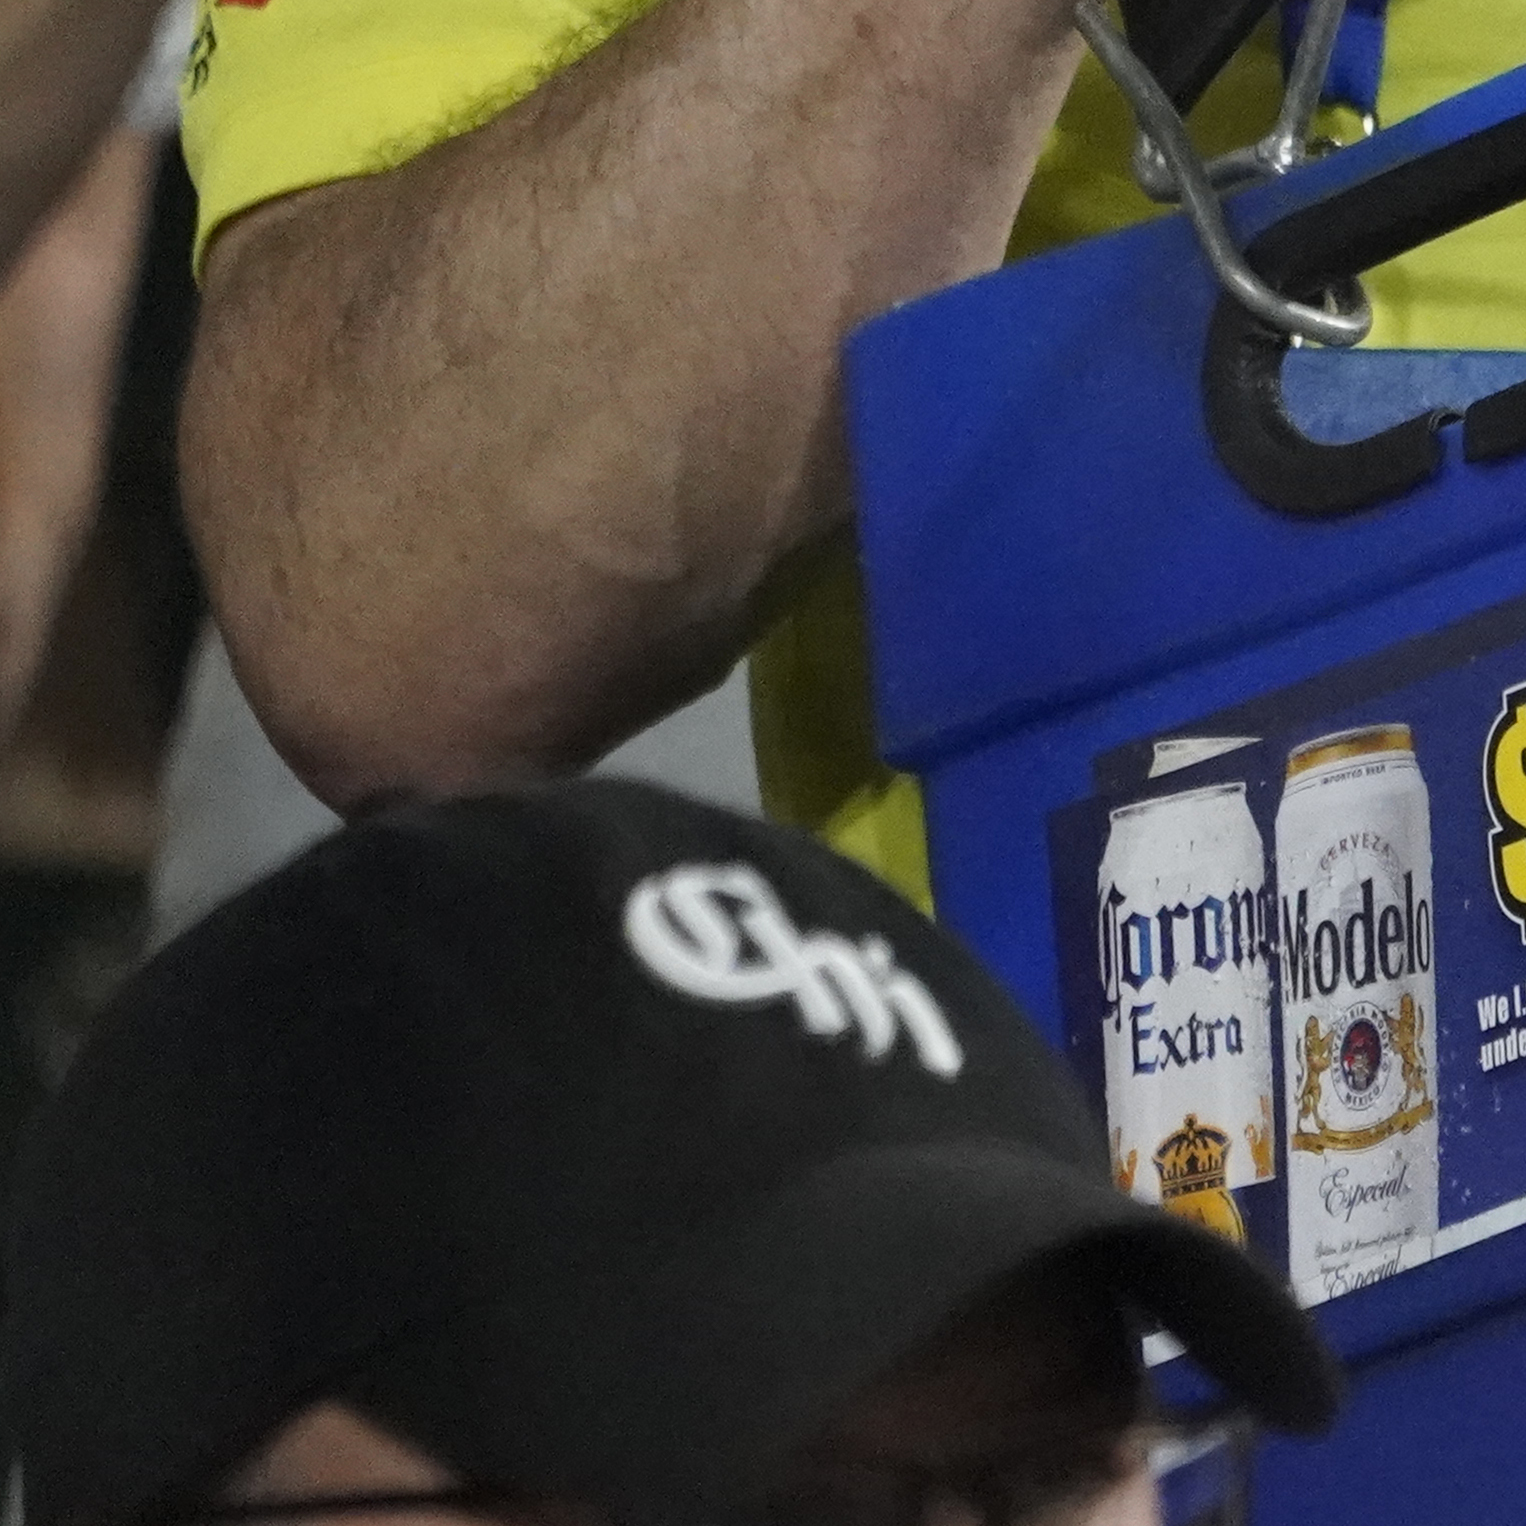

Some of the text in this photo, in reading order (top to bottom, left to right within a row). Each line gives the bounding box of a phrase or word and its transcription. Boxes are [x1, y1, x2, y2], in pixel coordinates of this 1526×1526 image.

[1320, 832, 1391, 871] CERVEZA
[1282, 870, 1431, 1004] Modelo
[1128, 1002, 1244, 1077] Extra
[1477, 993, 1509, 1032] We
[1318, 1163, 1408, 1224] Especial
